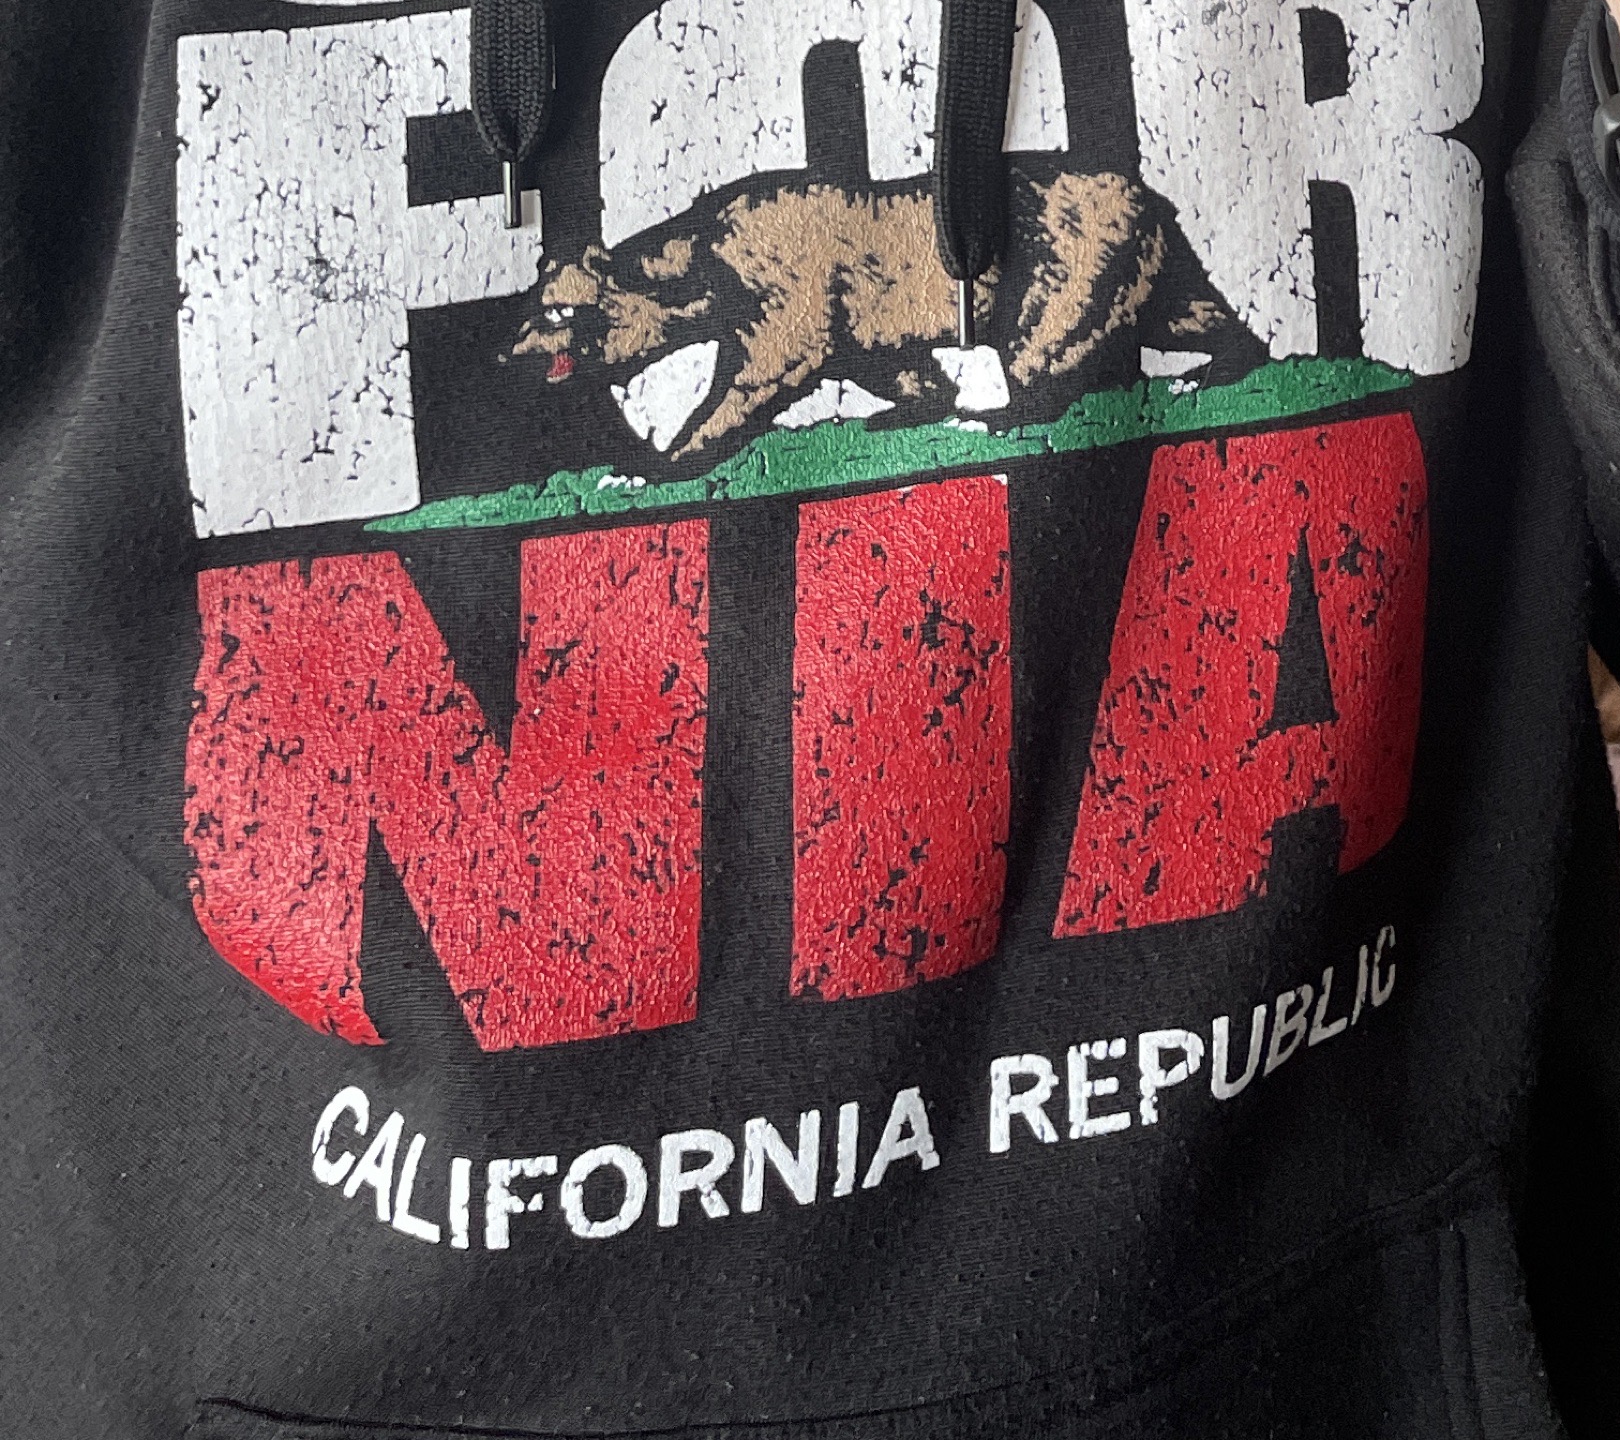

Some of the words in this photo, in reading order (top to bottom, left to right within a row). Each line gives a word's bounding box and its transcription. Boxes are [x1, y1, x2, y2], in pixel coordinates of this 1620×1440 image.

[184, 413, 1432, 1050] NIA
[312, 1086, 942, 1251] CALIFORNIA
[988, 926, 1398, 1155] REPUBLIC
